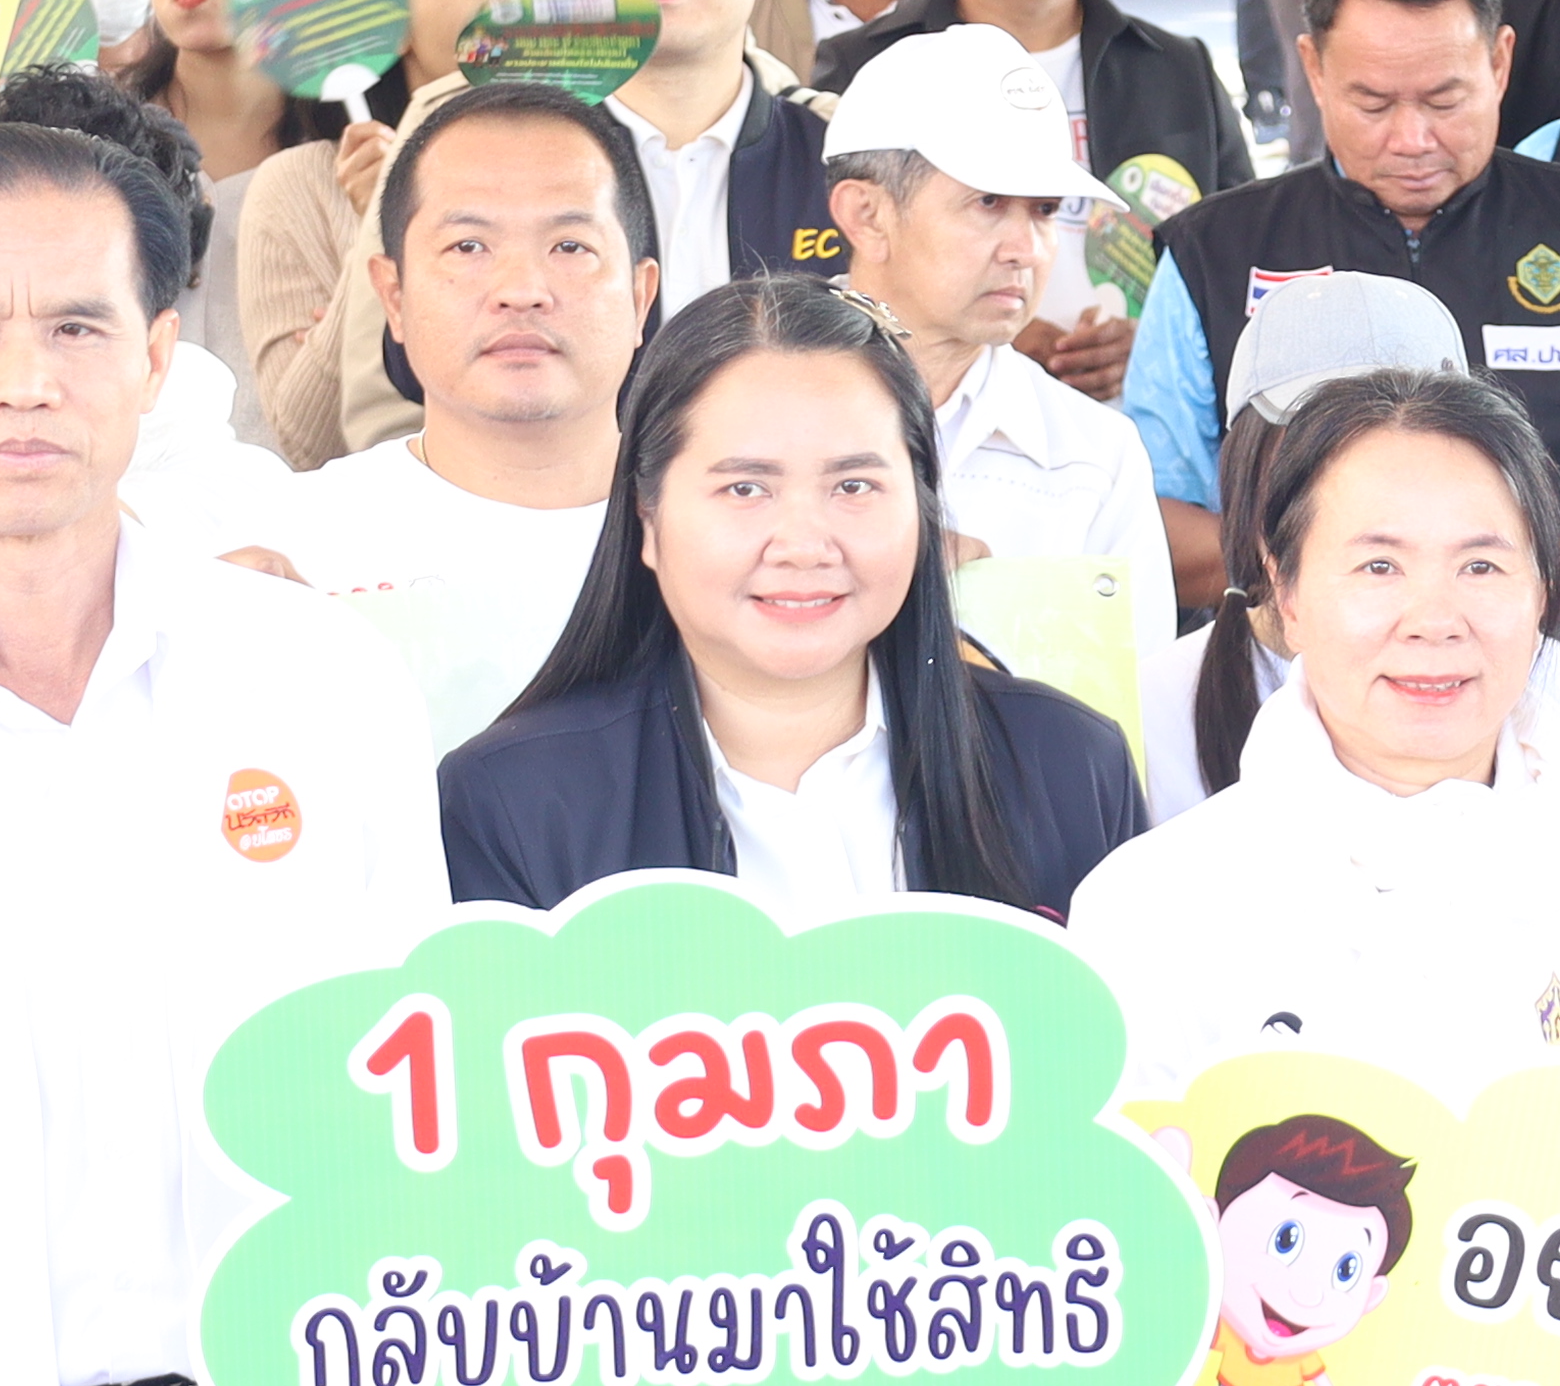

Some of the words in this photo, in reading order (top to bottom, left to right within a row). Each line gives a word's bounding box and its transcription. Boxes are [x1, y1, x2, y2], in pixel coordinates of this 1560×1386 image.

[227, 785, 279, 811] OTOP
[365, 1010, 440, 1155] 1
[520, 1012, 994, 1215] กุมภา
